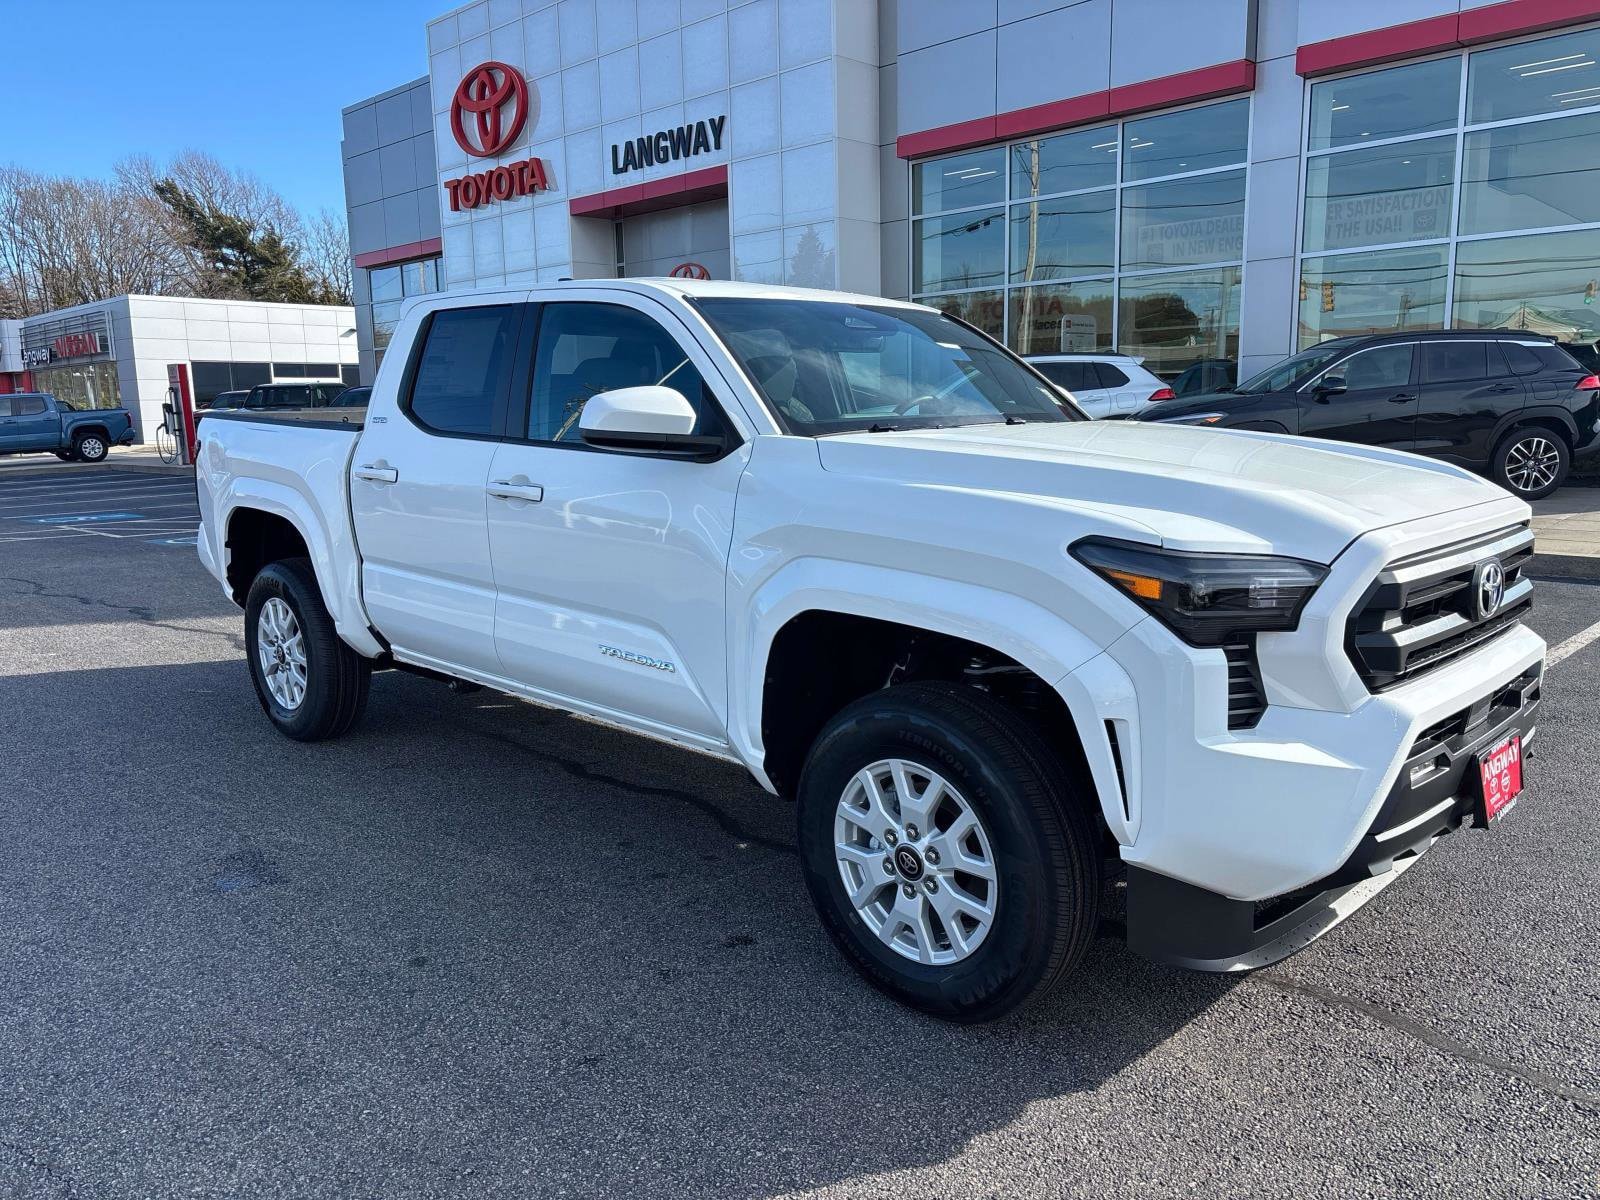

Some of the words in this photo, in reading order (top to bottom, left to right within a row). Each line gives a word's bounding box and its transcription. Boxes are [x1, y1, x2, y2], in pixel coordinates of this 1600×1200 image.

[610, 115, 726, 175] LANGWAY
[444, 157, 548, 212] TOYOTA
[1346, 188, 1448, 217] SATISFACTION
[1161, 219, 1203, 240] TOYOTA
[1336, 221, 1361, 240] THE
[1366, 214, 1402, 236] USA!!
[1172, 241, 1185, 258] IN
[1189, 238, 1216, 256] NEW
[55, 331, 101, 359] NISSAN
[598, 644, 676, 673] TACOMA
[1482, 744, 1519, 785] ANGWAY
